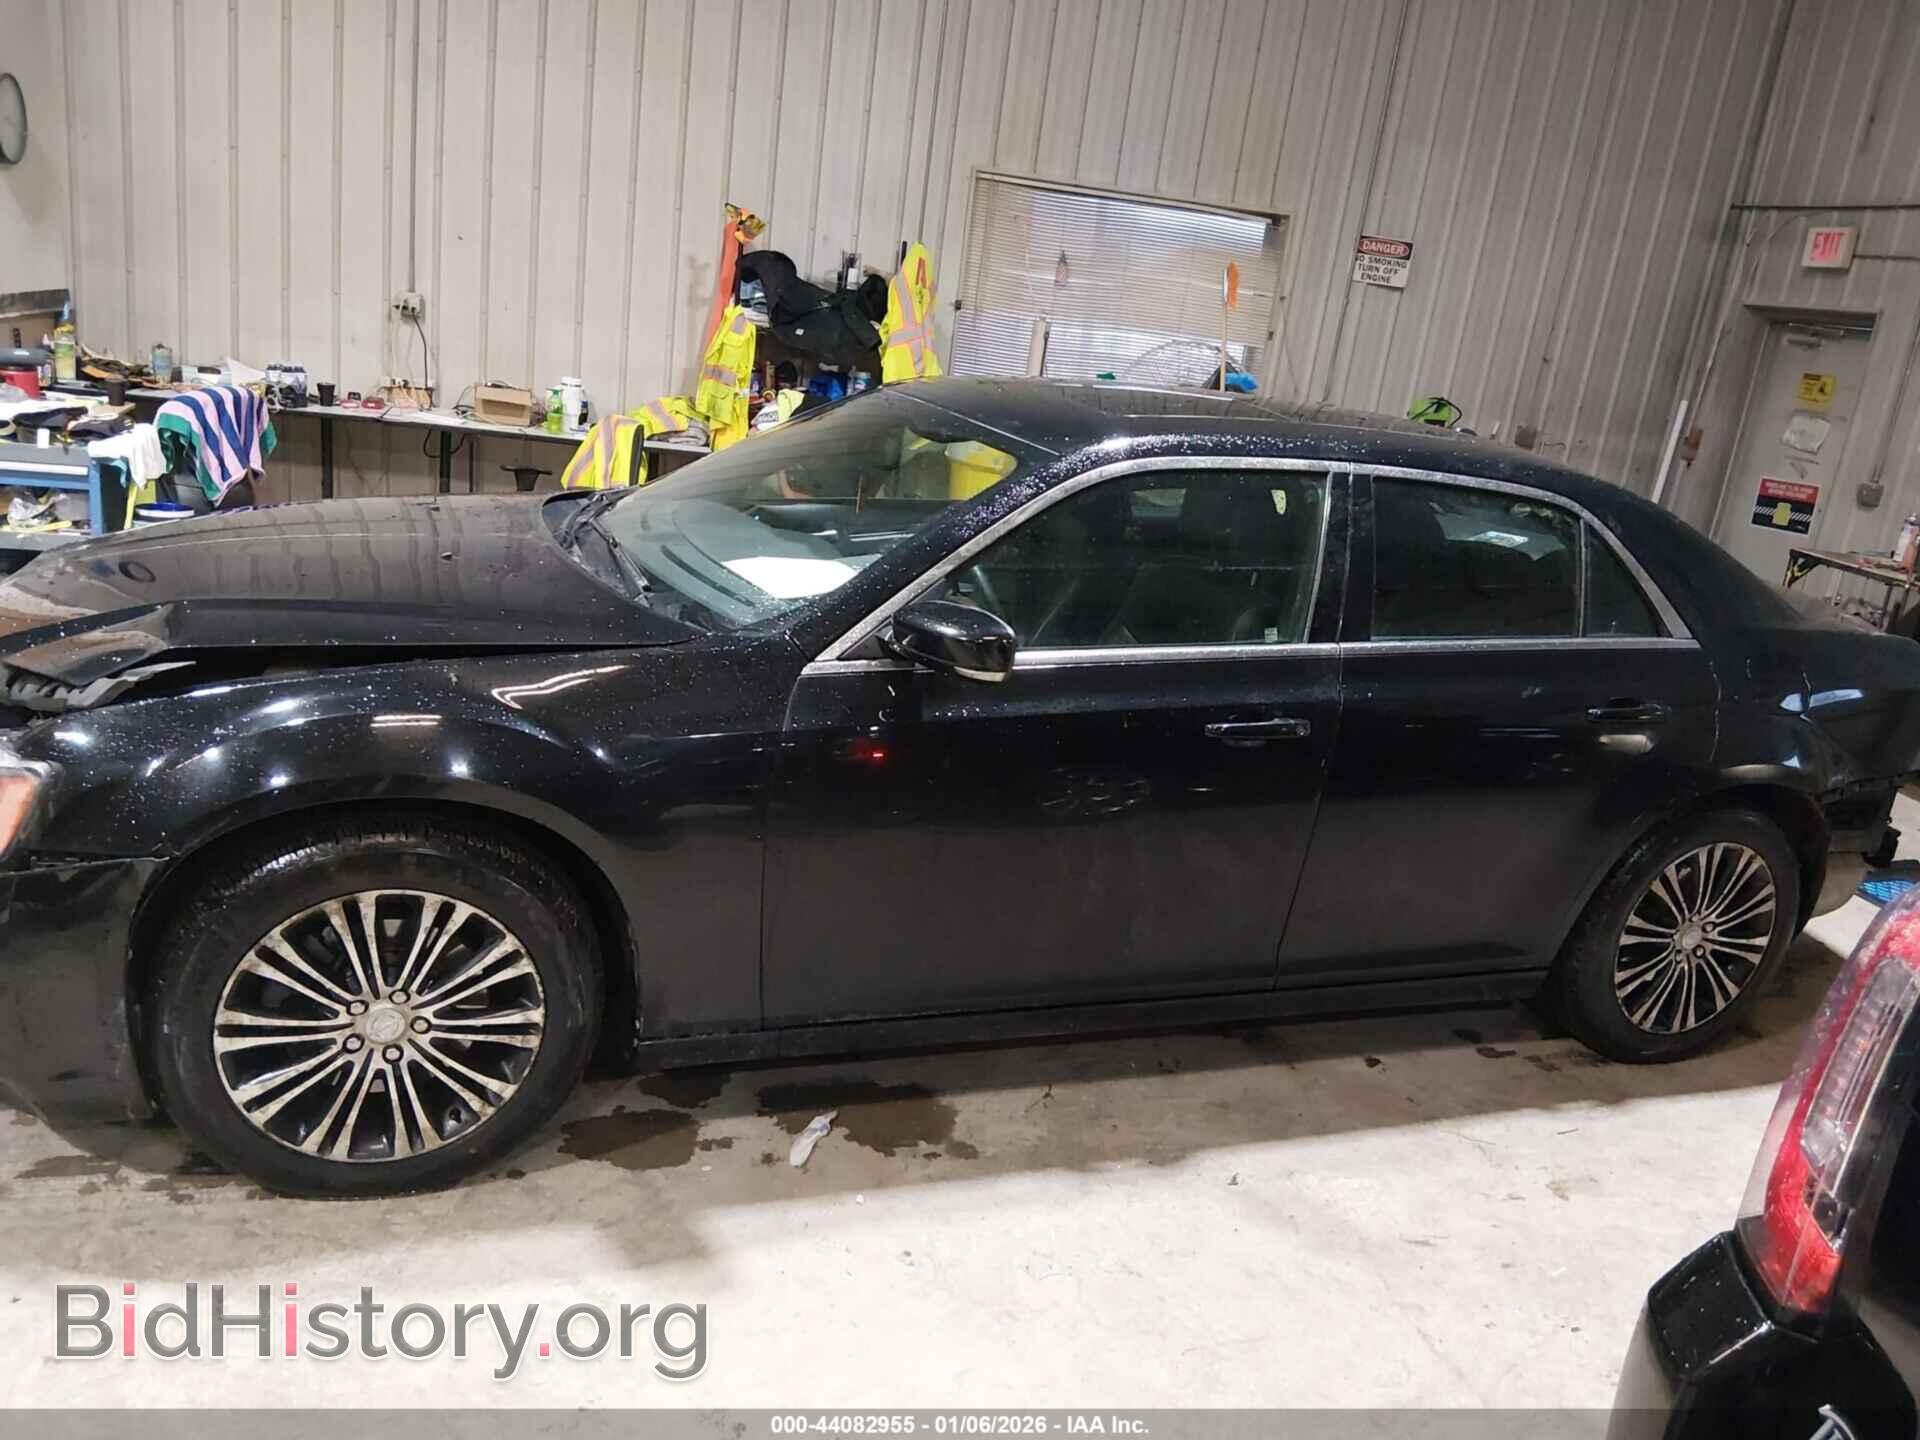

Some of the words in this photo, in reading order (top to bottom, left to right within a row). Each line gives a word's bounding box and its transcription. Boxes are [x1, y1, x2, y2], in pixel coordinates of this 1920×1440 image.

[1362, 240, 1407, 256] DANGER
[1811, 231, 1845, 256] EXIT
[1358, 262, 1380, 273] TURN
[1382, 266, 1400, 275] OFF
[1368, 256, 1408, 269] SMOKING
[1360, 271, 1391, 284] ENGINE
